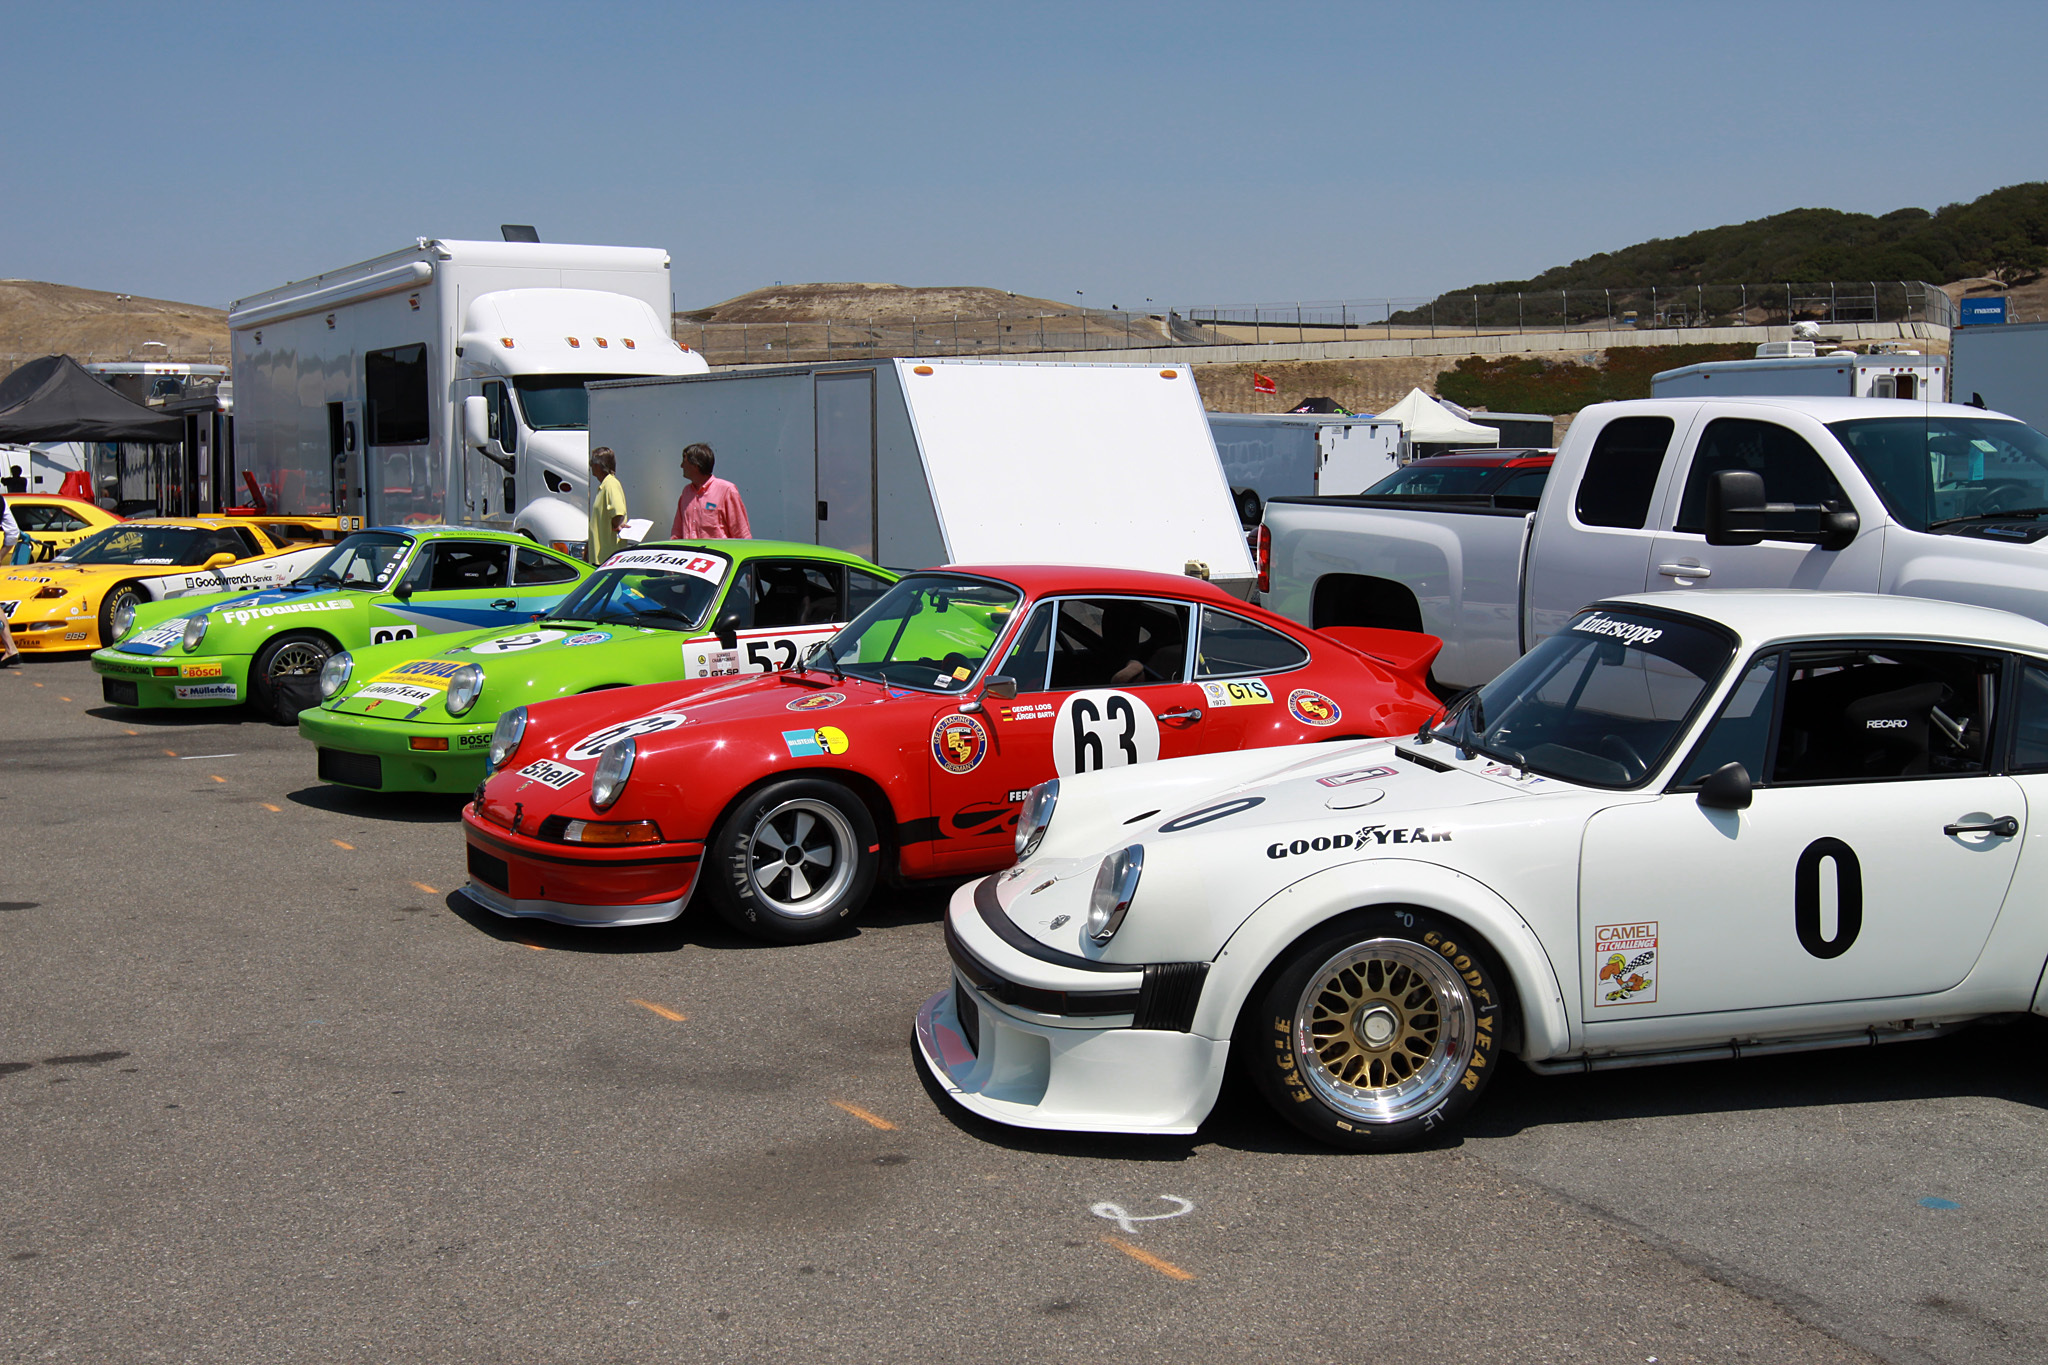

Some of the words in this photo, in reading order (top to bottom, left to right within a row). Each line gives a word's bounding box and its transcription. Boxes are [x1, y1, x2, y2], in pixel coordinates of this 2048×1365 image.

[195, 573, 252, 588] Goodwrench
[253, 574, 273, 583] Service
[222, 599, 341, 624] FOTOQUELLE
[64, 632, 87, 641] BBS
[745, 639, 798, 675] 52
[189, 668, 222, 677] BOSCH
[711, 669, 739, 677] GT-SP
[190, 685, 236, 695] Müllerbräu
[1227, 682, 1268, 699] GTS
[1012, 704, 1034, 713] GEORG
[1035, 703, 1052, 711] LOOS
[1015, 712, 1037, 721] JÜRGEN
[1037, 711, 1055, 719] BARTH
[1866, 719, 1908, 729] RECARO
[1071, 695, 1138, 774] 63
[788, 738, 815, 746] BILSTEIN
[944, 761, 974, 771] GERMANY
[521, 761, 580, 787] Shell
[1794, 836, 1863, 960] 0
[1598, 925, 1655, 941] CAMEL
[1597, 942, 1610, 952] GT
[1609, 939, 1655, 950] CHALLENGE
[1275, 1016, 1312, 1103] EAGLE
